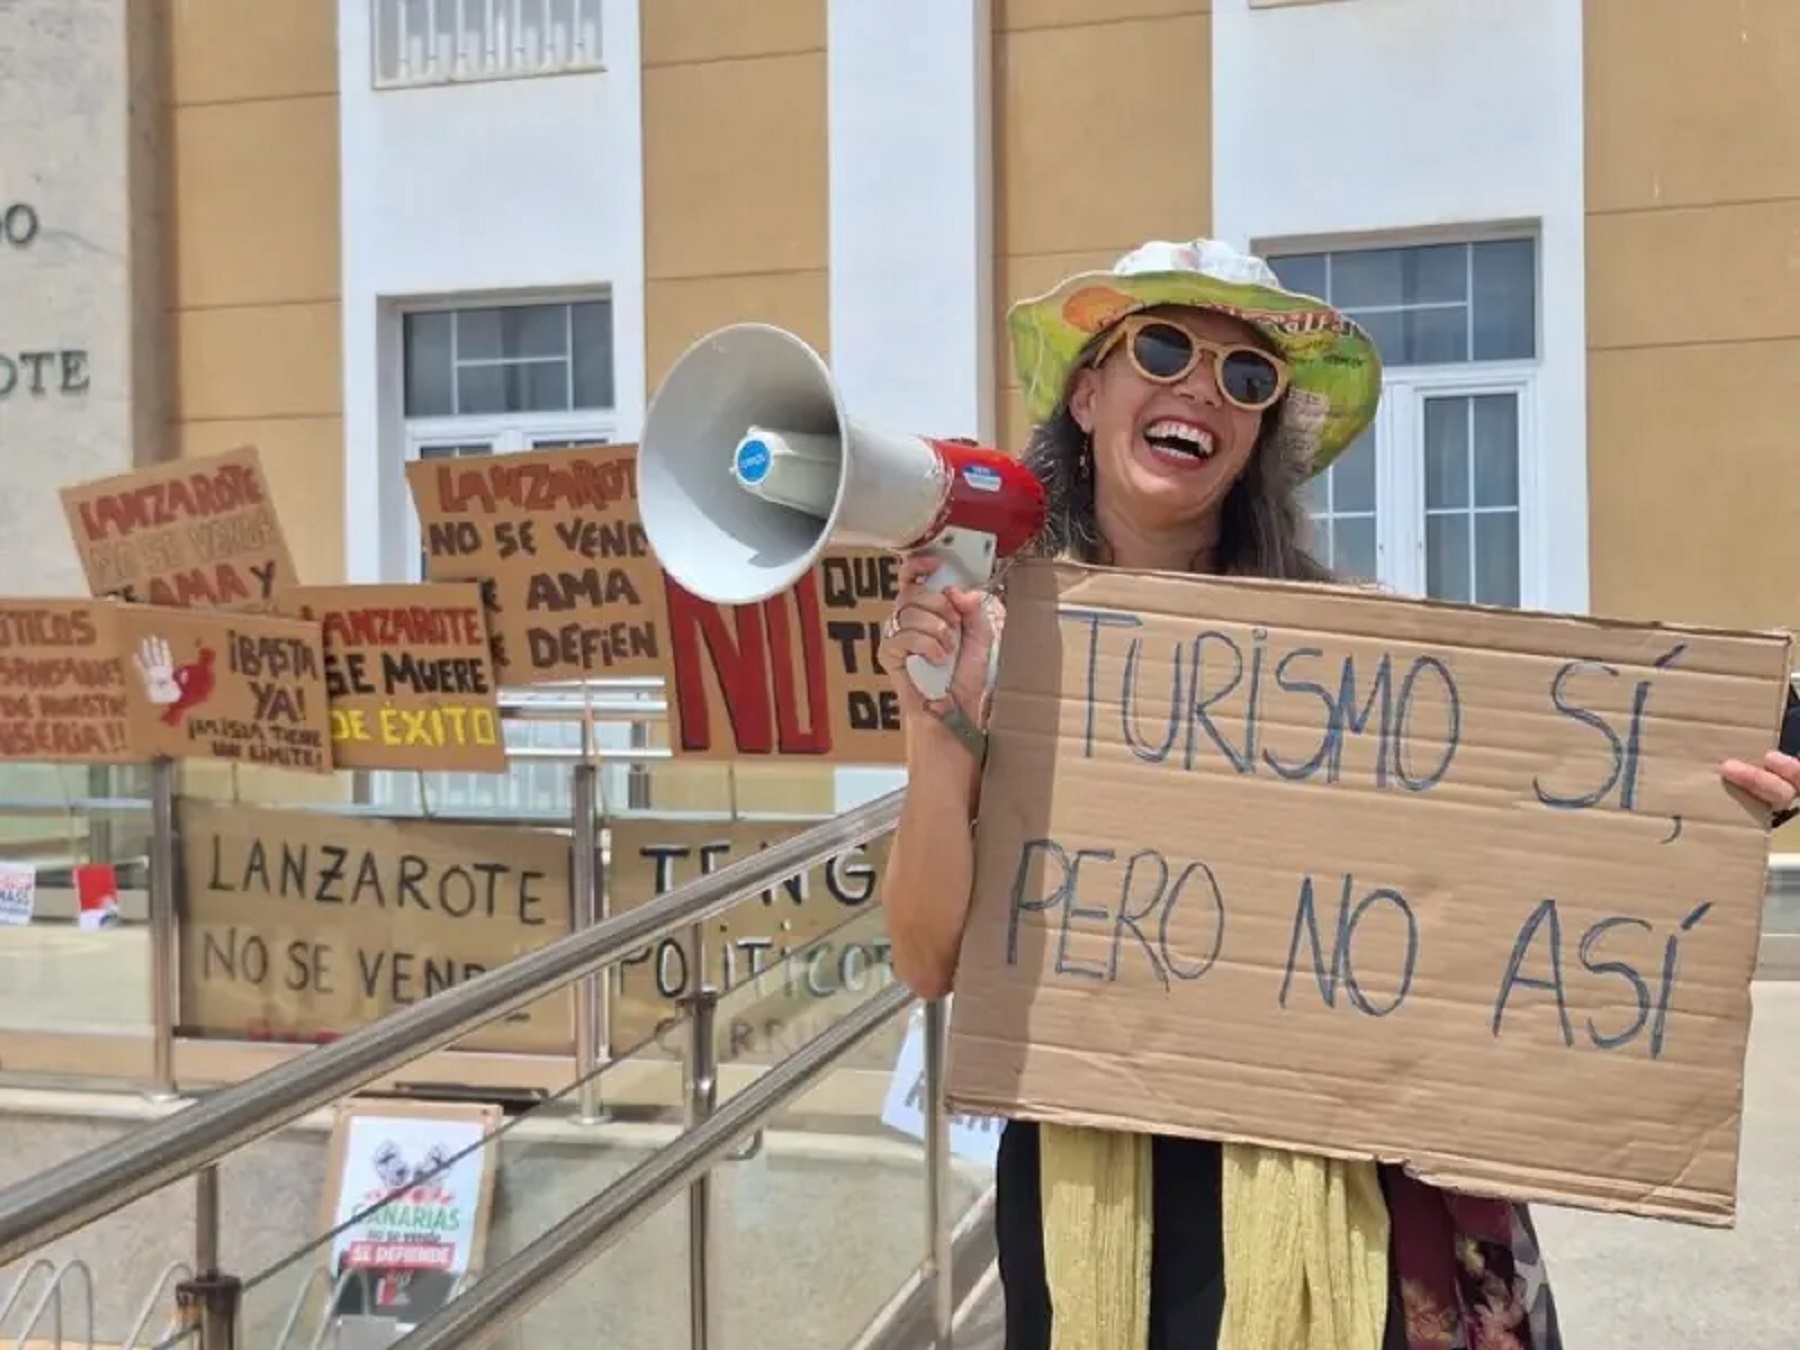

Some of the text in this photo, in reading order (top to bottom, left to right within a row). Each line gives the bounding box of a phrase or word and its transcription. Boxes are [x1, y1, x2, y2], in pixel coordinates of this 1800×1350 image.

[0, 203, 39, 246] O
[79, 464, 264, 541] LANZAROTE
[428, 521, 483, 556] NO
[494, 519, 537, 559] SE
[148, 563, 252, 609] AMA
[249, 560, 276, 600] Y
[526, 567, 641, 612] AMA
[325, 651, 490, 699] SE MUERE
[248, 681, 307, 722] YA!
[331, 700, 497, 747] DE ÉXITO
[206, 834, 548, 926] LANZAROTE
[201, 926, 270, 985] NO
[285, 940, 335, 994] SE
[1006, 838, 1714, 1061] PERO NO ASÍ
